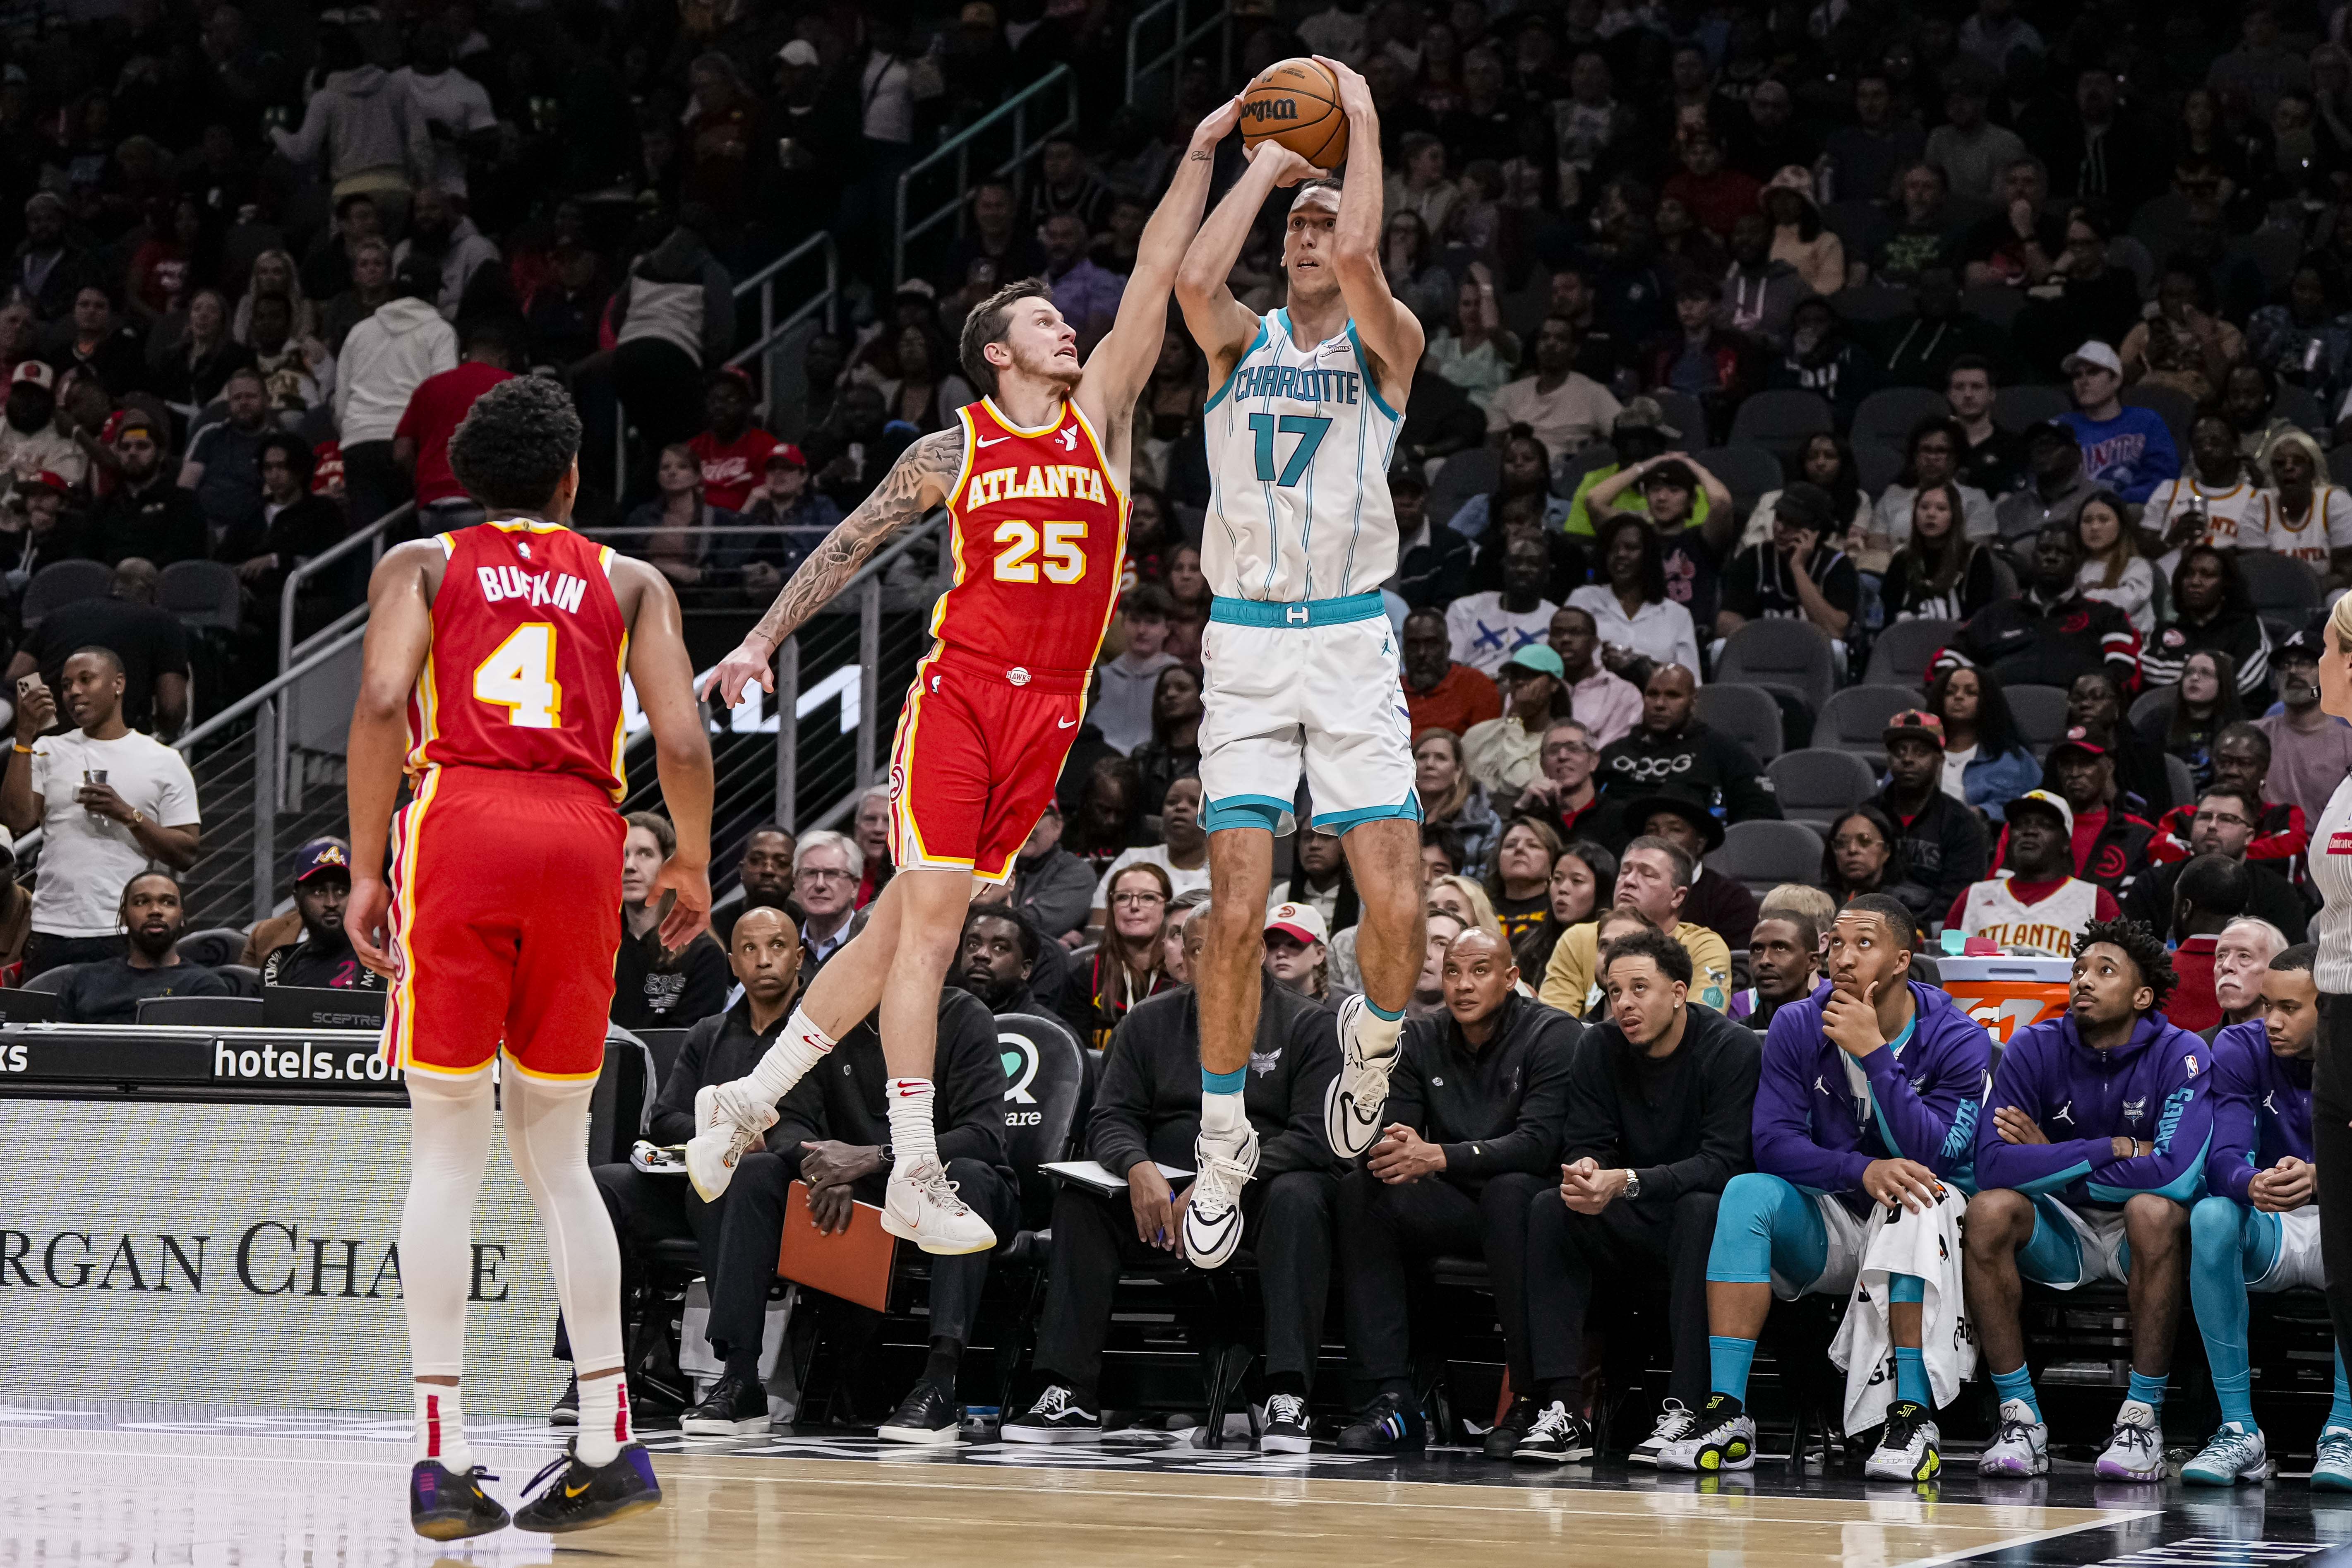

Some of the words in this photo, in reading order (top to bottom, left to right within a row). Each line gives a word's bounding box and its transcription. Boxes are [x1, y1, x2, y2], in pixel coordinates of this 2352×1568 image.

[1241, 97, 1298, 122] Wilso
[1235, 365, 1358, 405] CHARLOTTE
[1248, 413, 1333, 487] 17
[966, 465, 1107, 514] ATLANTA
[993, 520, 1088, 585] 25
[477, 566, 587, 614] BUFKIN
[473, 622, 562, 728] 4
[1006, 671, 1031, 682] HAWKS
[1978, 922, 2071, 958] ATLANTA
[312, 1012, 381, 1027] SCEPTRE
[215, 1040, 408, 1081] hotels.co
[1005, 1112, 1042, 1126] are
[0, 1229, 211, 1293] RGAN
[236, 1220, 509, 1302] CHAE
